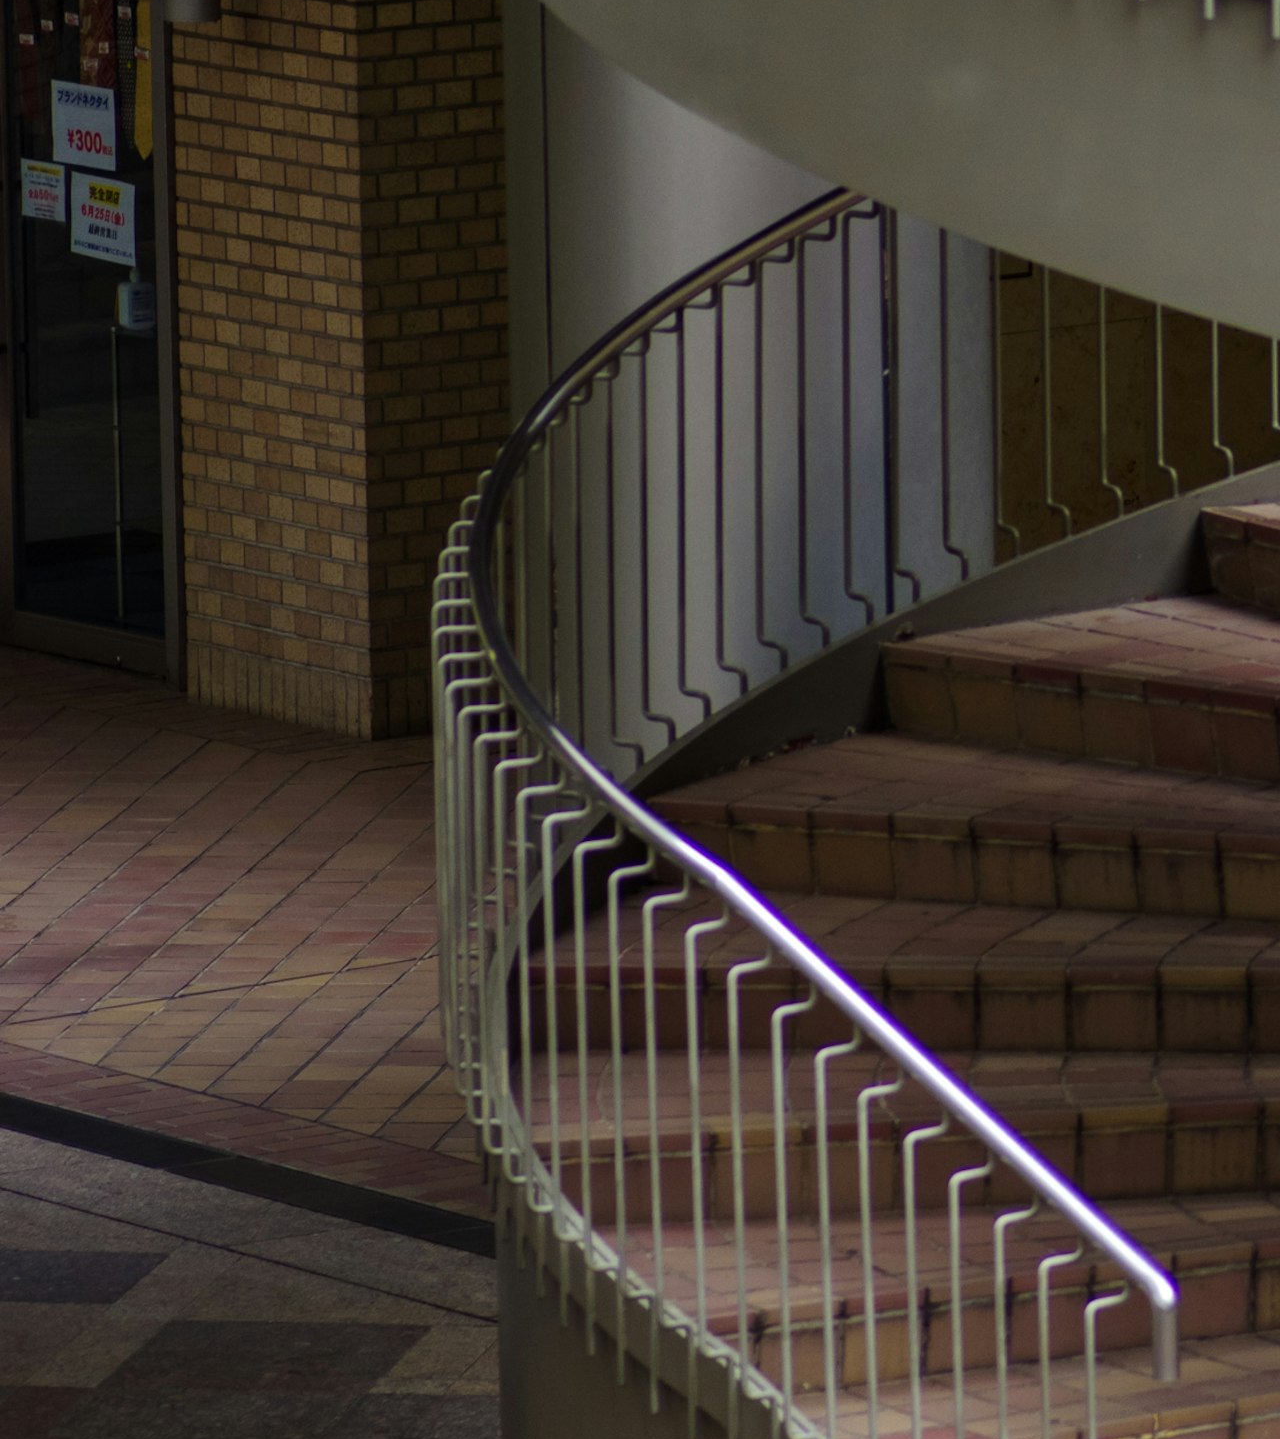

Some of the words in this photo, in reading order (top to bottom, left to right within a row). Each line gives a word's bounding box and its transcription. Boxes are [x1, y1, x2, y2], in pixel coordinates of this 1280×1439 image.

[56, 88, 109, 110] ブランドネクタイ
